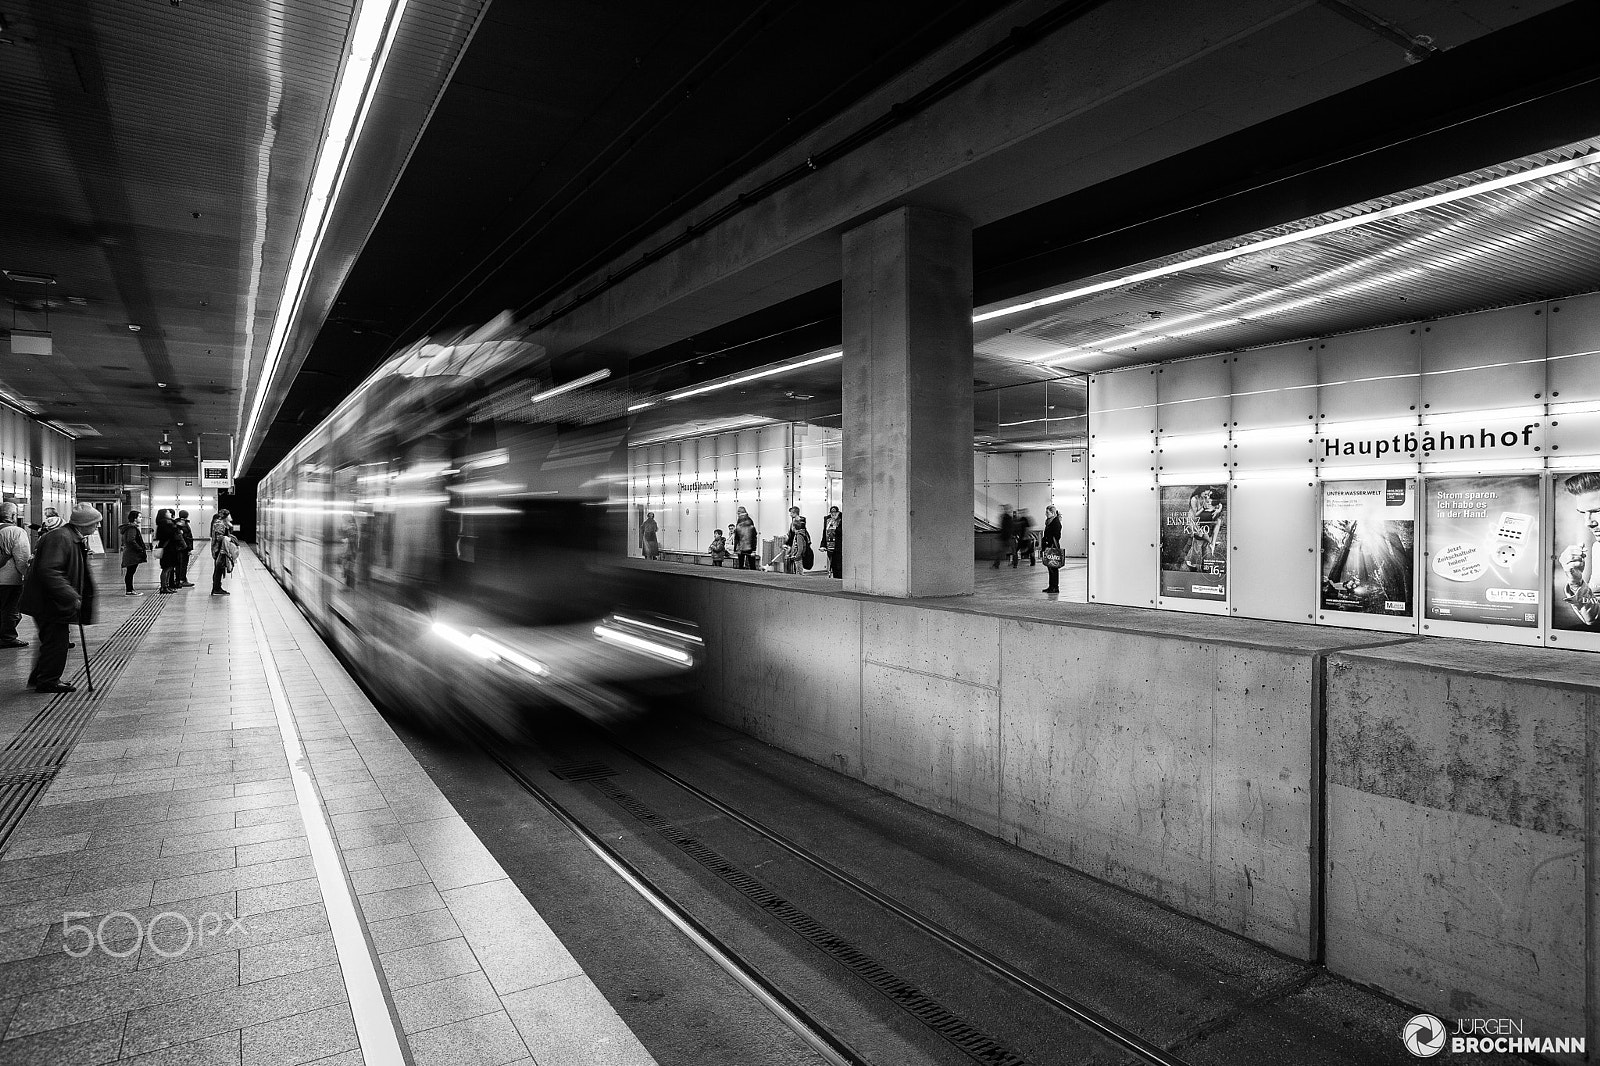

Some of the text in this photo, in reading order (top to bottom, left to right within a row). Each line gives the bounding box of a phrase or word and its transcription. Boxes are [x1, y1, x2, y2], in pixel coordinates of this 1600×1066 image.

[1325, 424, 1534, 459] Hauptbahnhof
[1437, 491, 1499, 501] Strom sparen.
[1437, 500, 1450, 509] Ich
[1452, 500, 1474, 509] habe
[1437, 510, 1489, 518] in der Hand.
